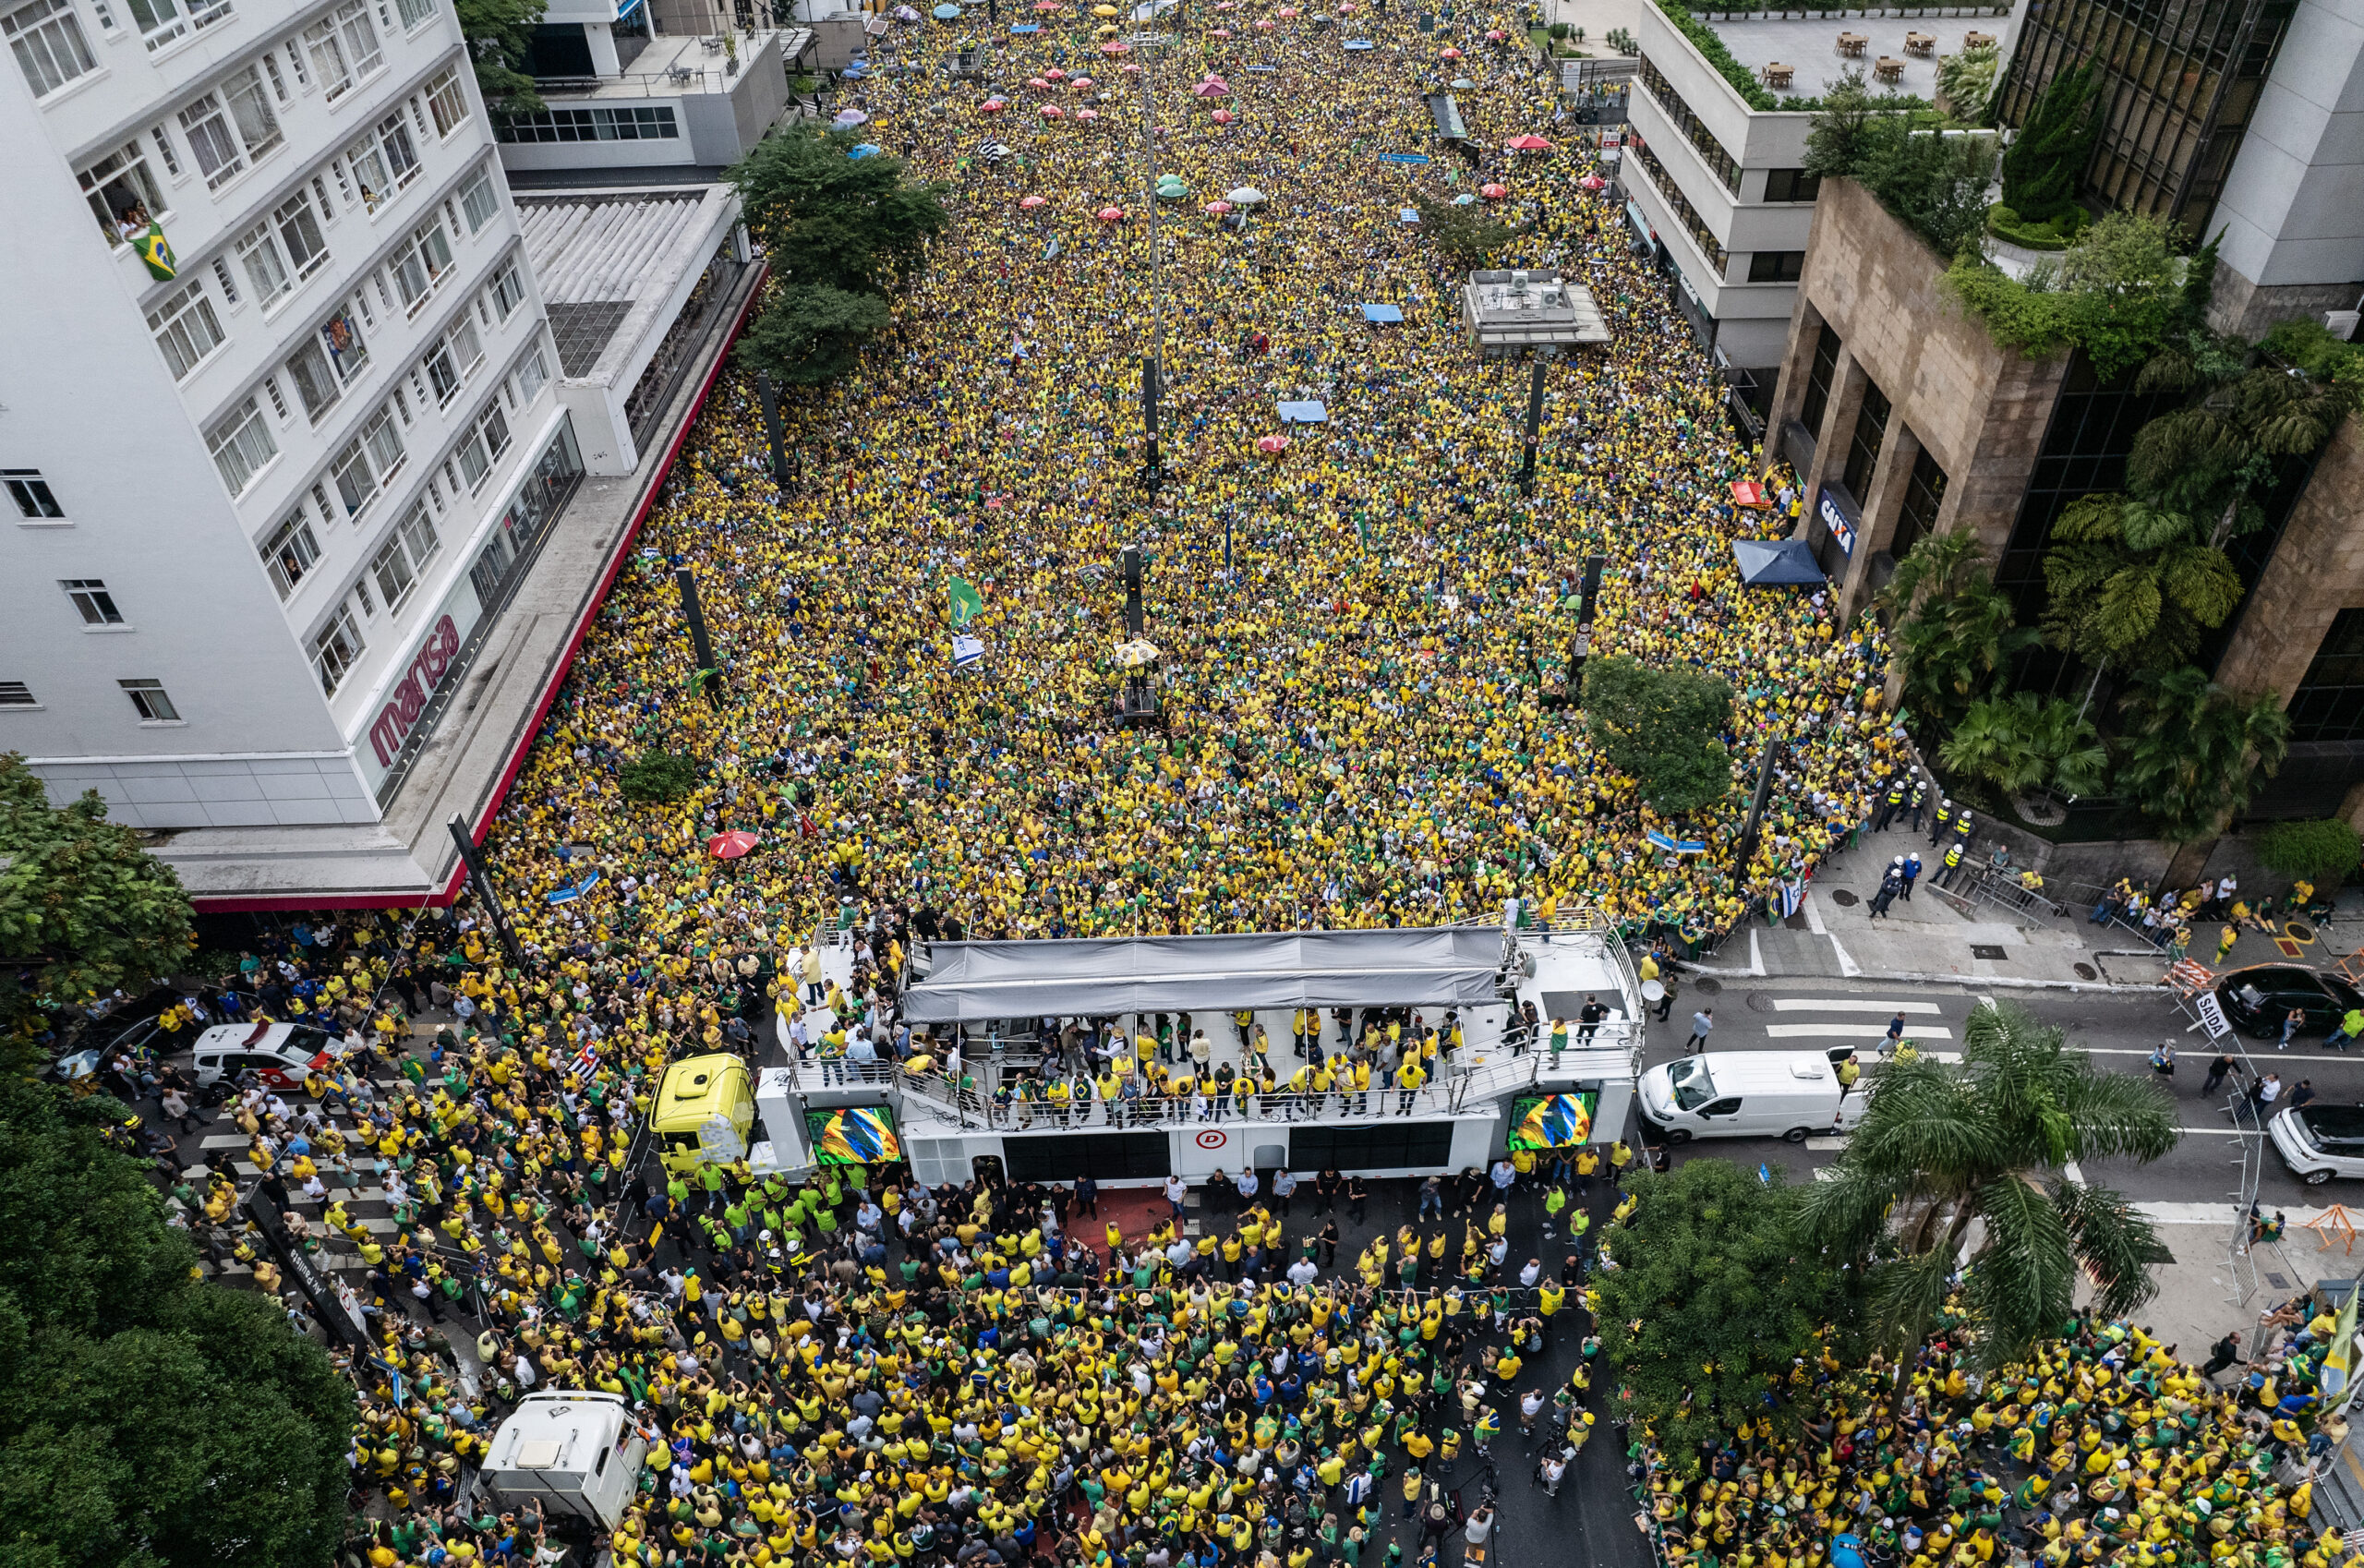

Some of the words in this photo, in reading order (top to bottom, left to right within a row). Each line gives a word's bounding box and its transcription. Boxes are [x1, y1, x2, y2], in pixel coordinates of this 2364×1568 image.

[1821, 500, 1851, 553] CAIXA
[369, 614, 460, 768] marisa
[480, 871, 497, 906] Paulista
[2200, 997, 2225, 1036] SAÍDA
[290, 1248, 315, 1286] Paulista
